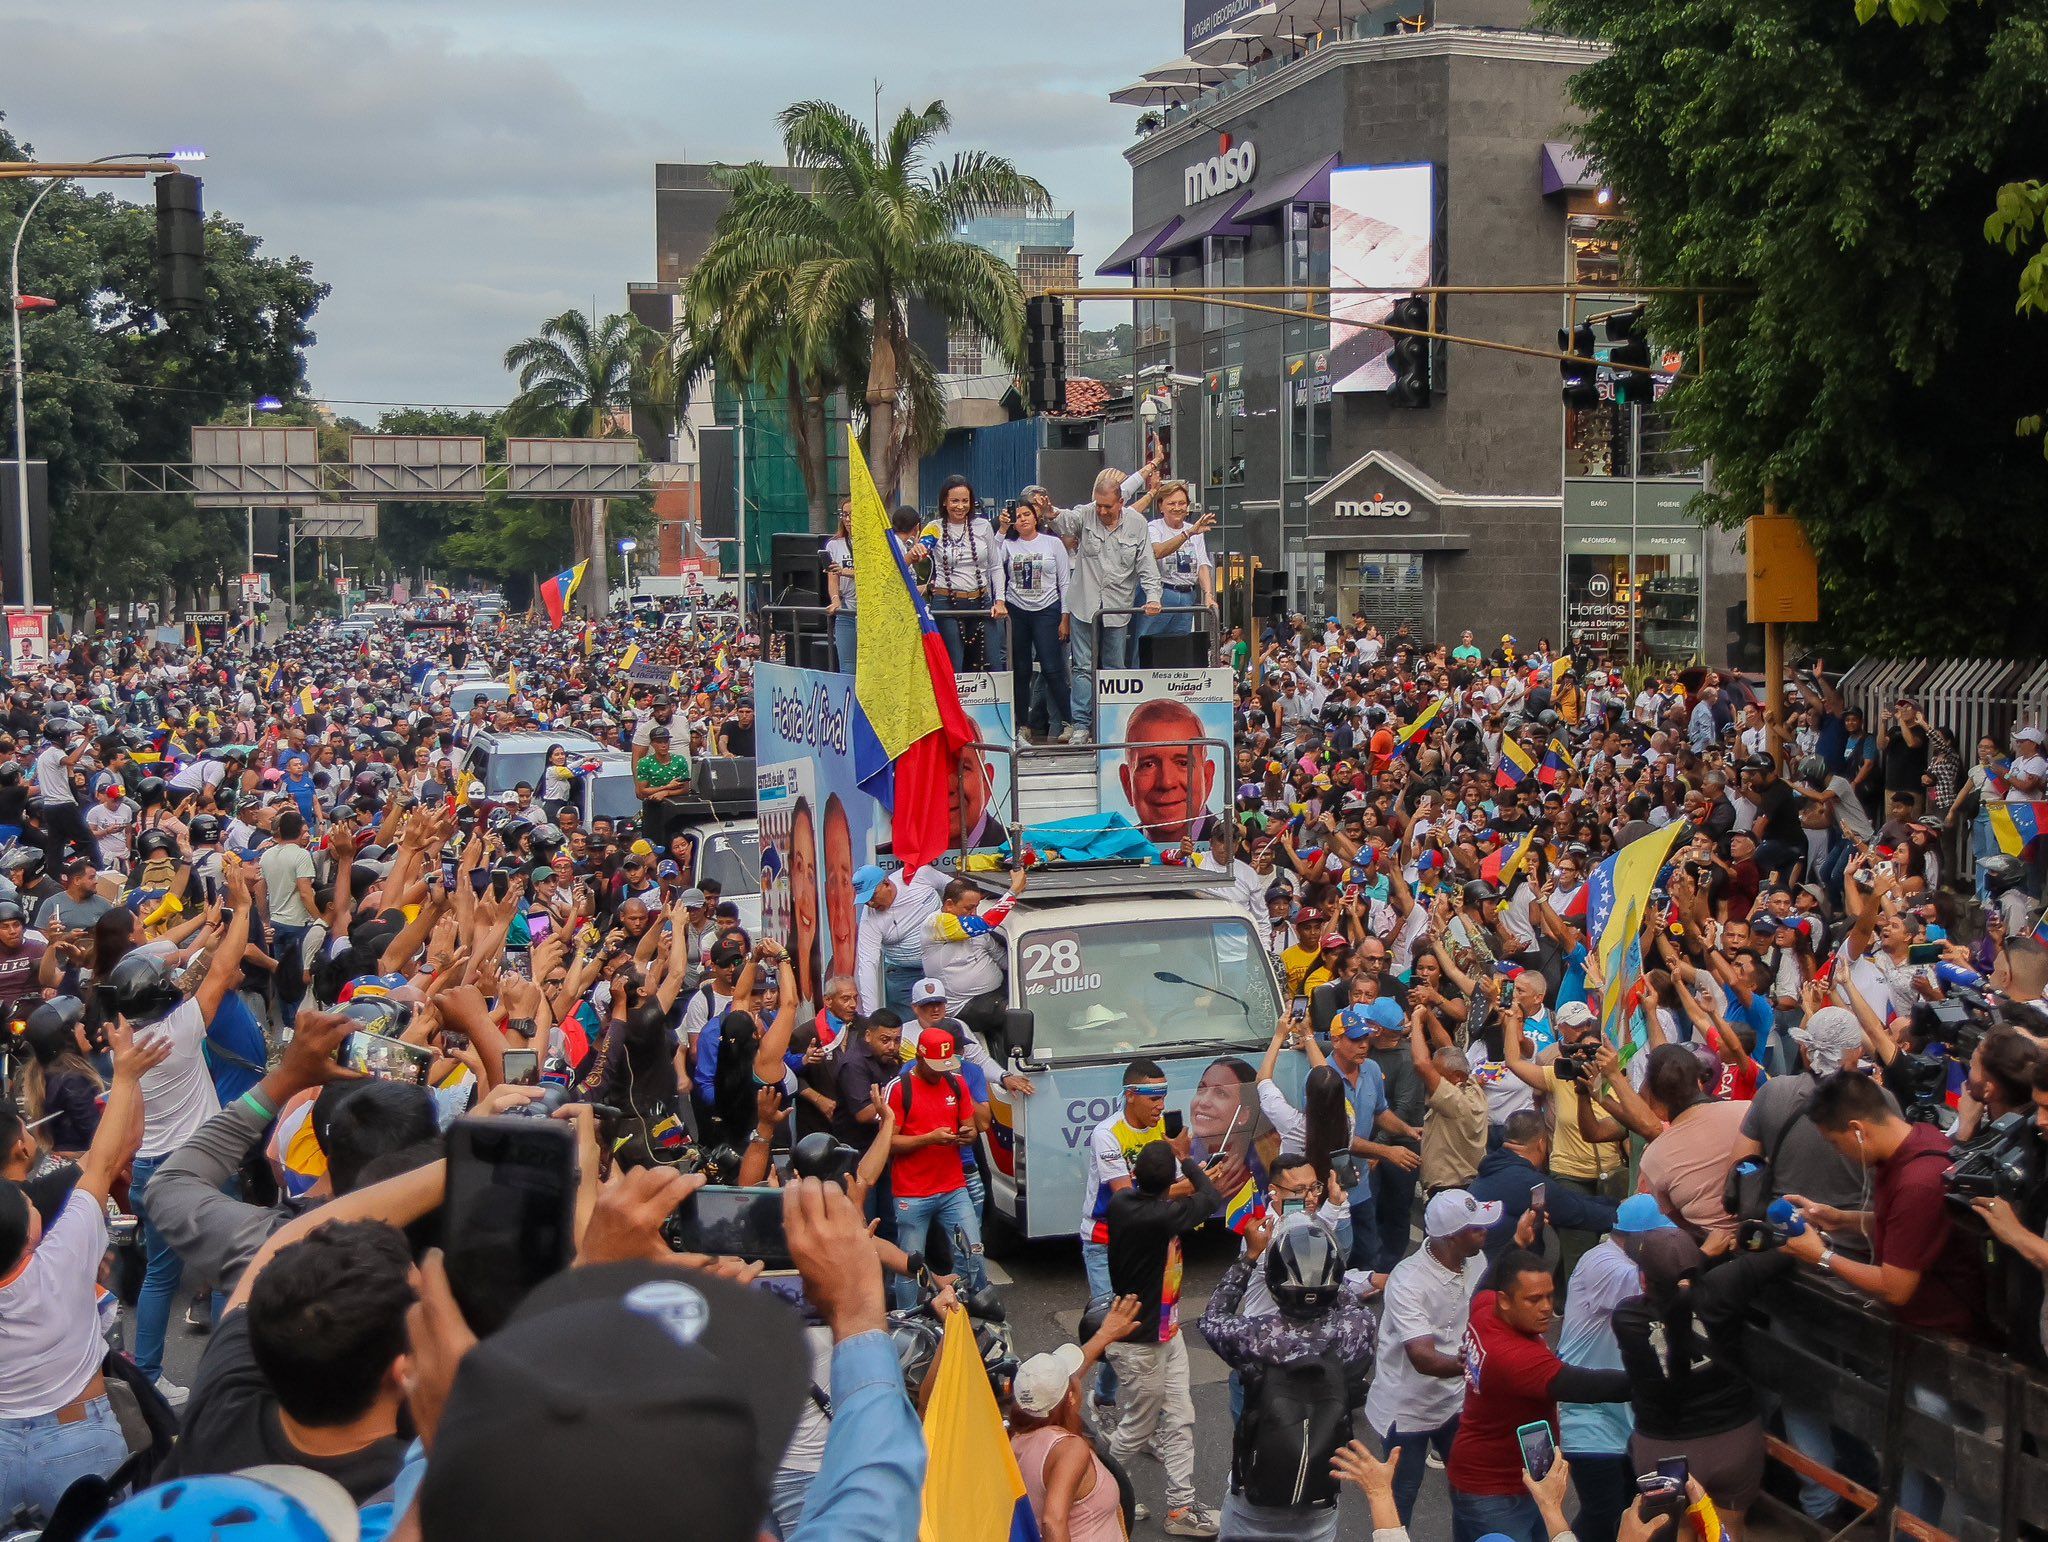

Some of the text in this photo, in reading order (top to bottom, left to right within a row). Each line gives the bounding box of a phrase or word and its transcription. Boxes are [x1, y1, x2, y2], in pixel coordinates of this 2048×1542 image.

[1185, 132, 1256, 206] maiso
[1335, 493, 1411, 516] maiso
[1569, 602, 1627, 616] Horarios
[185, 614, 224, 622] ELEGANCE
[1596, 619, 1626, 629] Domingo
[1152, 671, 1172, 679] Mesa
[1099, 679, 1143, 694] MUD
[1167, 683, 1202, 692] Unidad
[771, 686, 804, 744] Hasta
[818, 683, 851, 758] final
[1022, 940, 1080, 980] 28
[1050, 973, 1101, 995] JULIO
